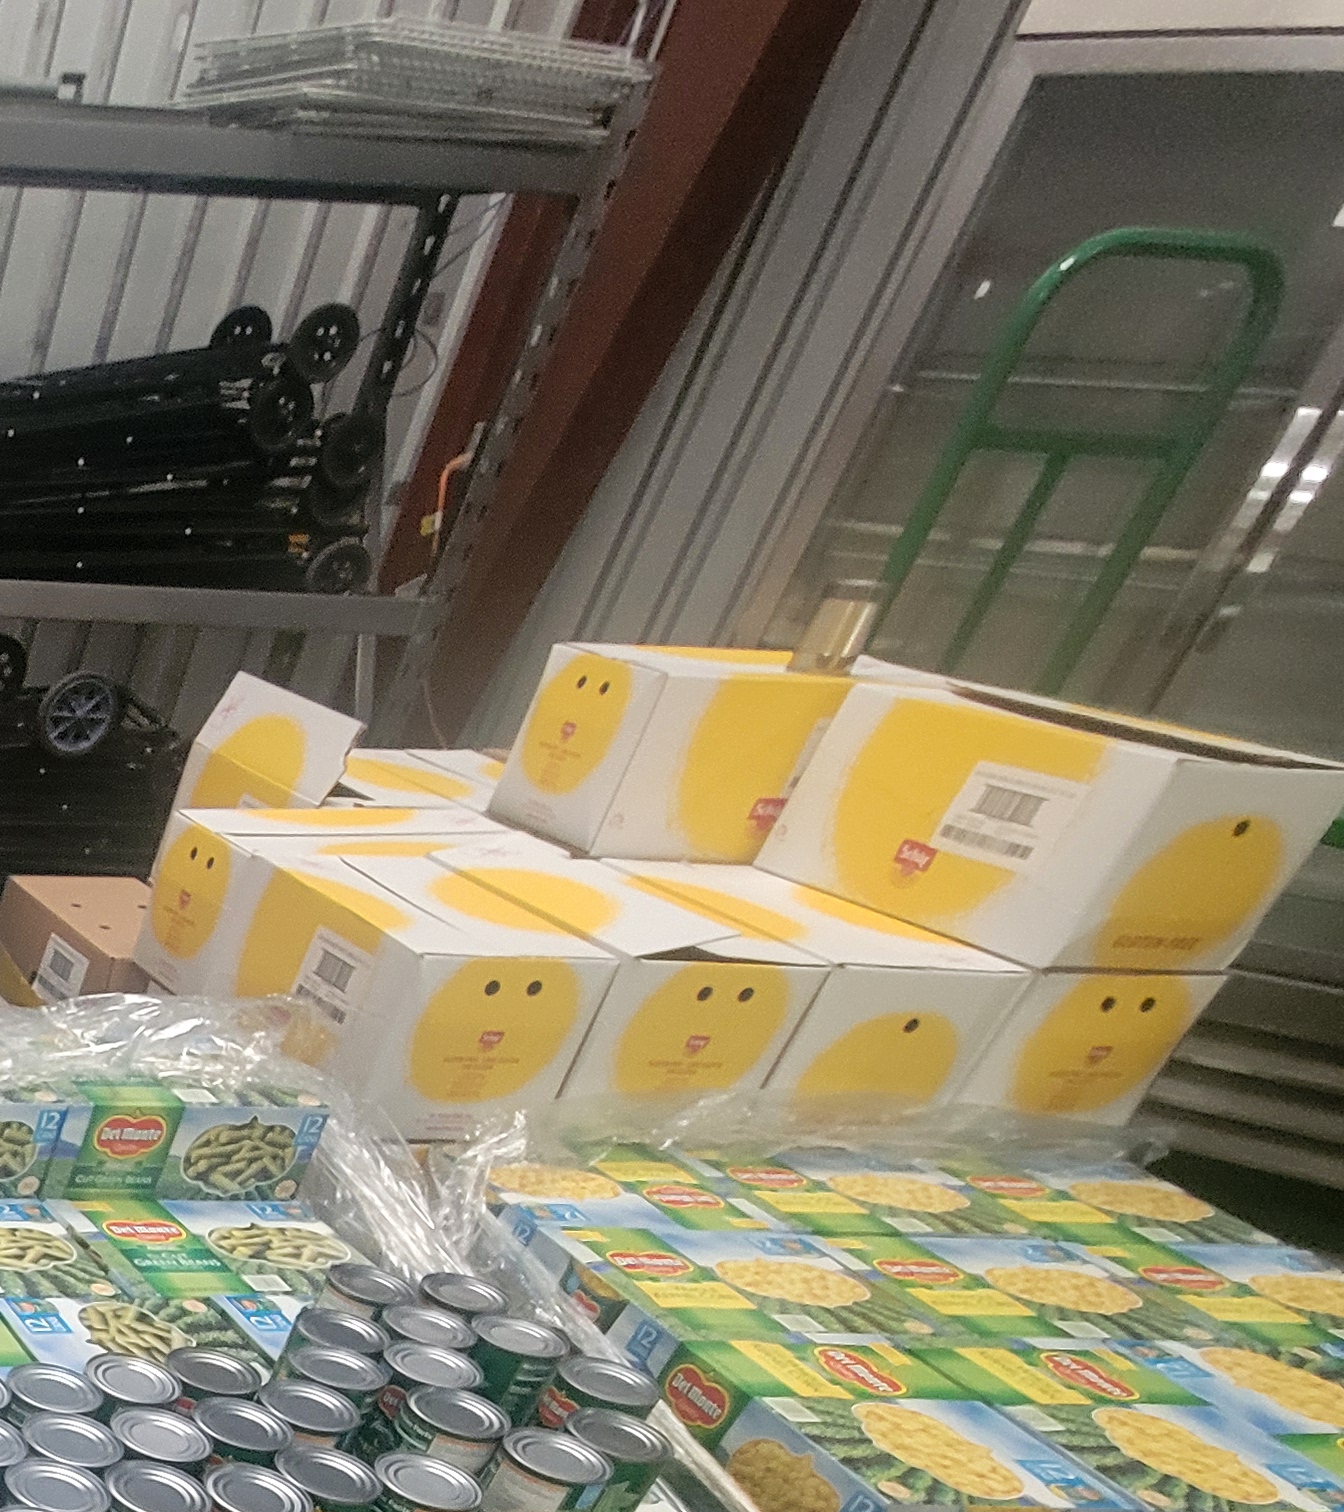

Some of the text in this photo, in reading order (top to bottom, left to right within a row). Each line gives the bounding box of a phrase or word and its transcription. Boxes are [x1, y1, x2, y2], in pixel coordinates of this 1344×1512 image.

[39, 1112, 61, 1130] 12
[302, 1116, 324, 1133] 12
[639, 1323, 659, 1347] 12
[672, 1373, 723, 1420] Del Monte
